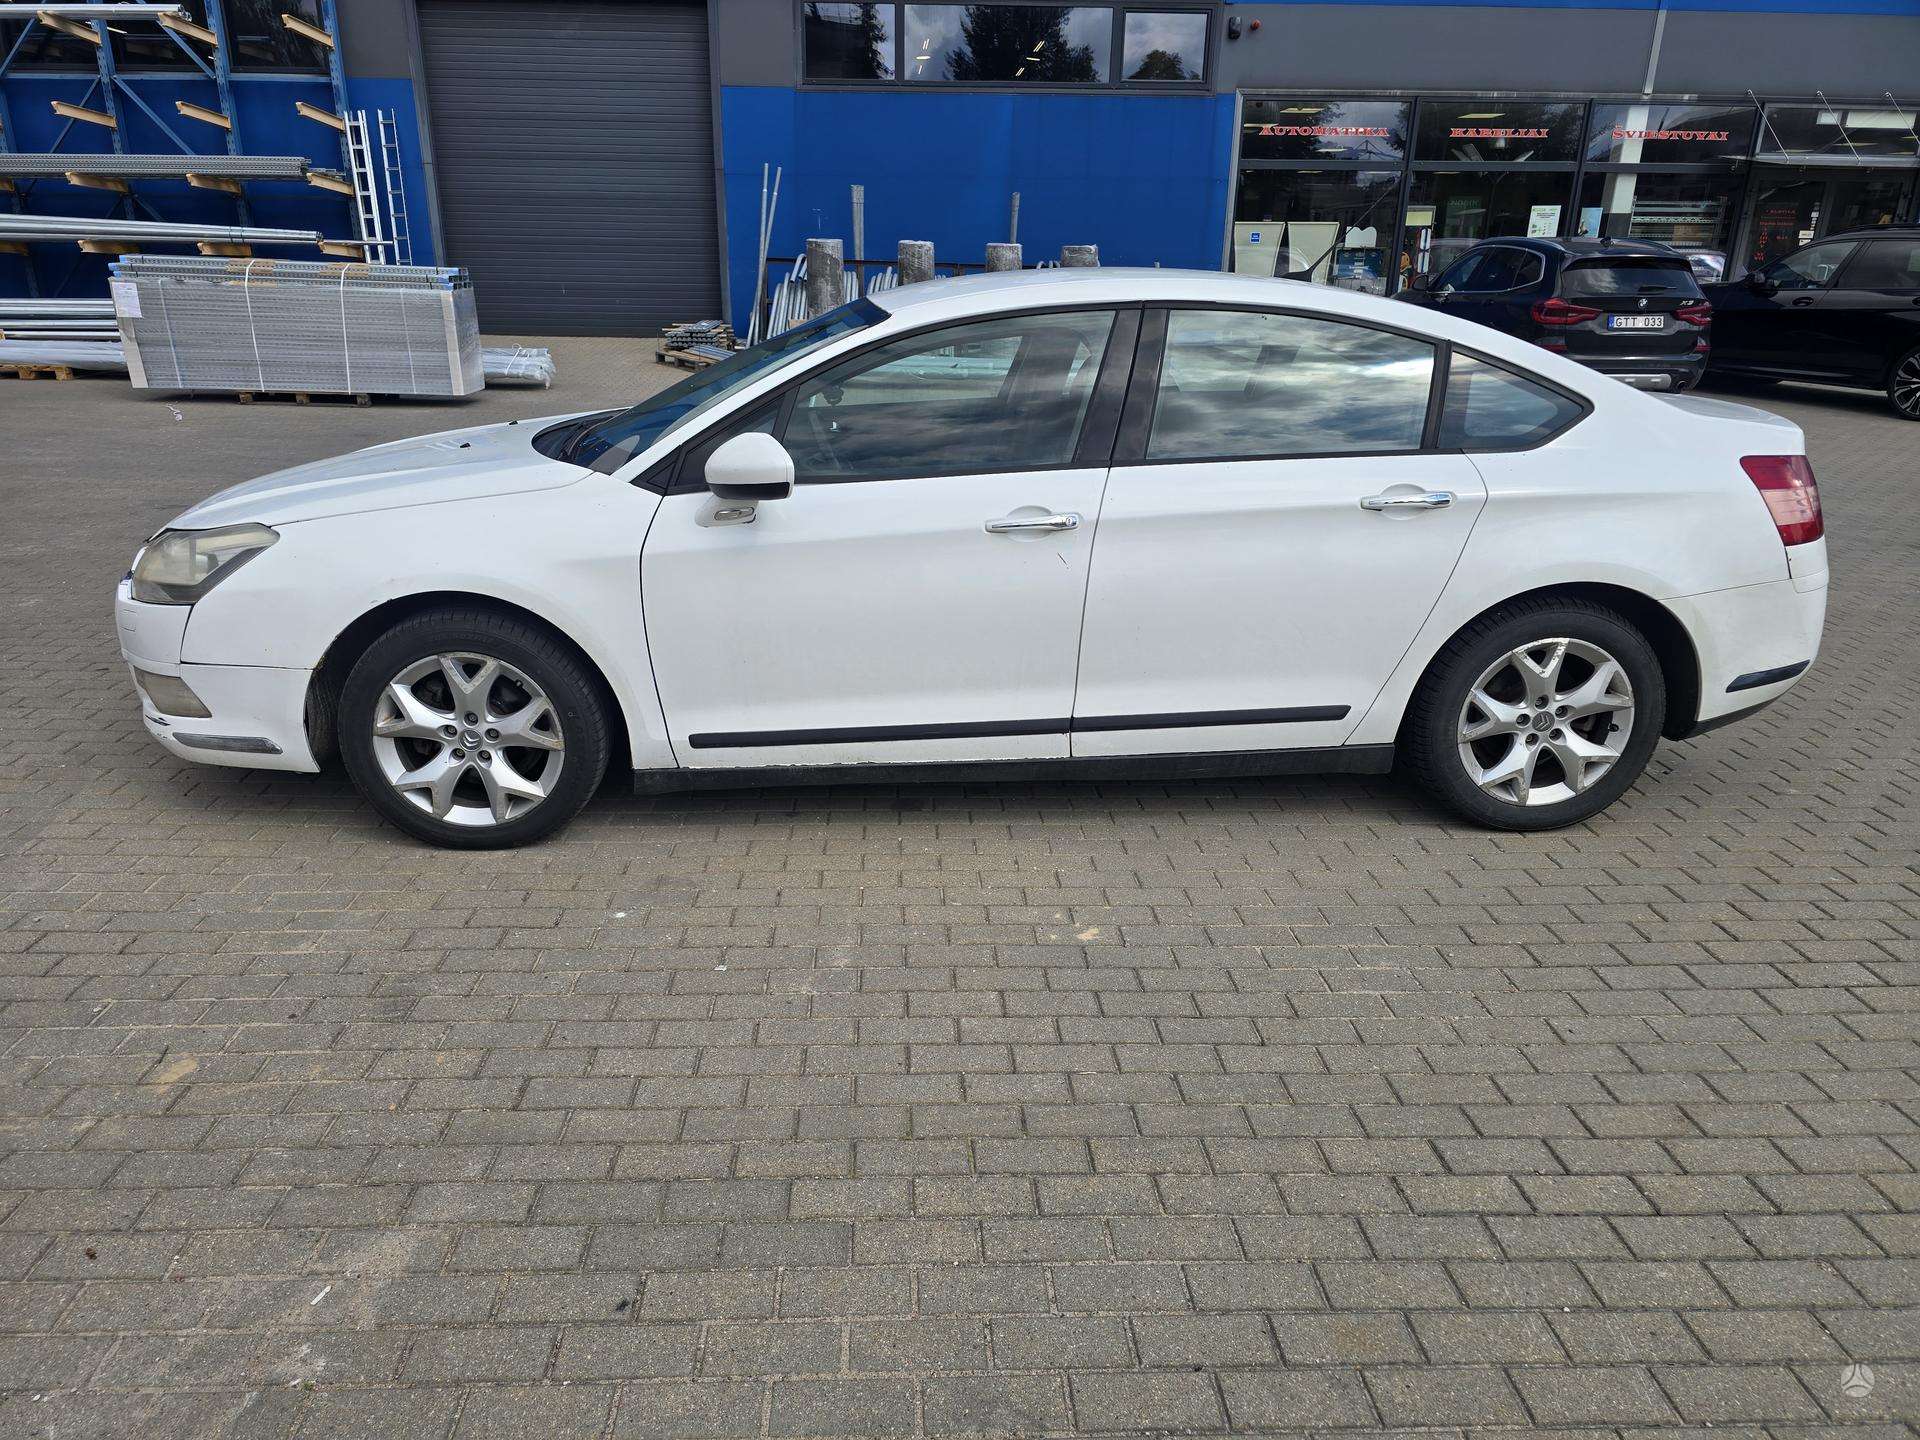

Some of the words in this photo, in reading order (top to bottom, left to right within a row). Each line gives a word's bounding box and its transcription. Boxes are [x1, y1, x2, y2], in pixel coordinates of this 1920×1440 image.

[1259, 125, 1390, 137] AUTOMATIKA
[1449, 127, 1549, 138] KABELIAI
[1611, 123, 1729, 141] ŠVIESTUVAI
[1616, 317, 1638, 327] GTT
[1644, 317, 1662, 327] 033
